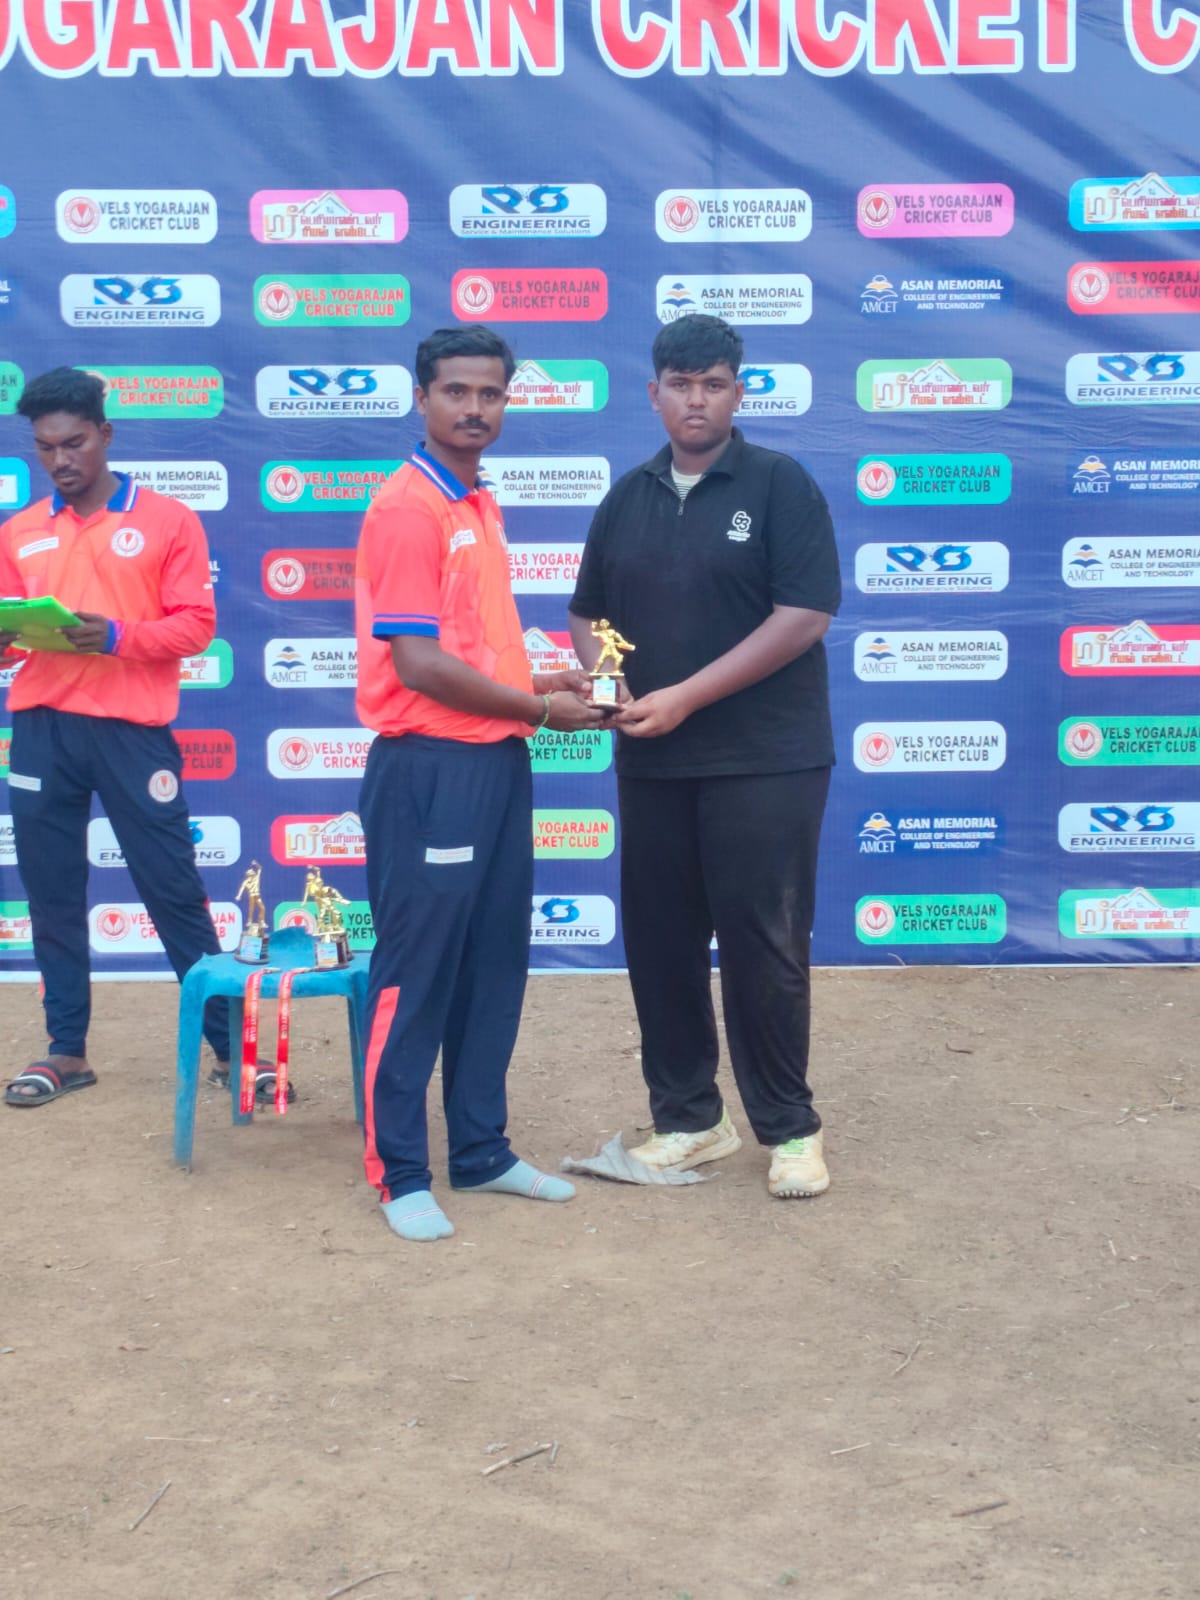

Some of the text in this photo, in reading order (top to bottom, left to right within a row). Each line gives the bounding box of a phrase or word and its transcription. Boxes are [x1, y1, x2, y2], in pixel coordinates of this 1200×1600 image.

[0, 0, 563, 78] GARAJAN
[699, 200, 806, 213] VELS YOGARAJAN
[894, 195, 1003, 208] VELS YOGARAJAN
[99, 202, 210, 215] VELS YOGARAJAN
[708, 215, 797, 228] CRICKET CLUB
[904, 210, 992, 223] CRICKET CLUB
[109, 217, 200, 231] CRICKET CLUB
[462, 219, 591, 229] ENGINEERING
[1143, 271, 1200, 283] YOGARAJ
[493, 280, 600, 293] VELS YOGARAJAN
[901, 279, 1004, 290] ASAN MEMORIAL
[295, 289, 404, 301] VELS YOGARAJAN
[701, 288, 804, 298] ASAN MEMORIAL
[1117, 287, 1170, 298] CRICKET
[502, 296, 590, 308] CRICKET CLUB
[74, 311, 205, 320] ENGINEERING
[305, 304, 395, 317] CRICKET CLUB
[110, 377, 219, 390] VELS YOGARAJAN
[119, 392, 209, 406] CRICKET CLUB
[268, 401, 400, 410] ENGINEERING
[895, 465, 1000, 478] VELS YOGARAJAN
[1113, 461, 1147, 471] ASAN
[156, 471, 222, 481] MEMORIAL
[303, 473, 395, 484] VELS YOGARA
[502, 470, 604, 481] ASAN MEMORIAL
[903, 480, 991, 493] CRICKET CLUB
[313, 487, 366, 499] CRICKET
[509, 553, 581, 565] ELS YOGARA
[1108, 549, 1141, 559] ASAN
[866, 577, 992, 587] ENGINEERING
[901, 642, 1003, 652] ASAN MEMORIAL
[311, 652, 343, 661] ASAN
[1101, 726, 1200, 740] VELS YOGARAJA
[531, 734, 601, 746] YOGARAJAN
[894, 736, 999, 748] VELS YOGARAJAN
[180, 744, 233, 755] ARAJAN
[314, 742, 343, 754] VELS
[1109, 740, 1196, 753] CRICKET CLUB
[529, 748, 593, 760] CKET CLUB
[903, 750, 990, 762] CRICKET CLUB
[191, 757, 223, 769] CLUB
[323, 756, 367, 768] CRICKE
[537, 822, 609, 834] YOGARAJAN
[898, 817, 998, 830] ASAN MEMORIAL
[534, 836, 600, 848] CKET CLUB
[1070, 836, 1196, 846] ENGINEERING
[893, 904, 997, 917] VELS YOGARAJAN
[902, 919, 987, 931] CRICKET CLUB
